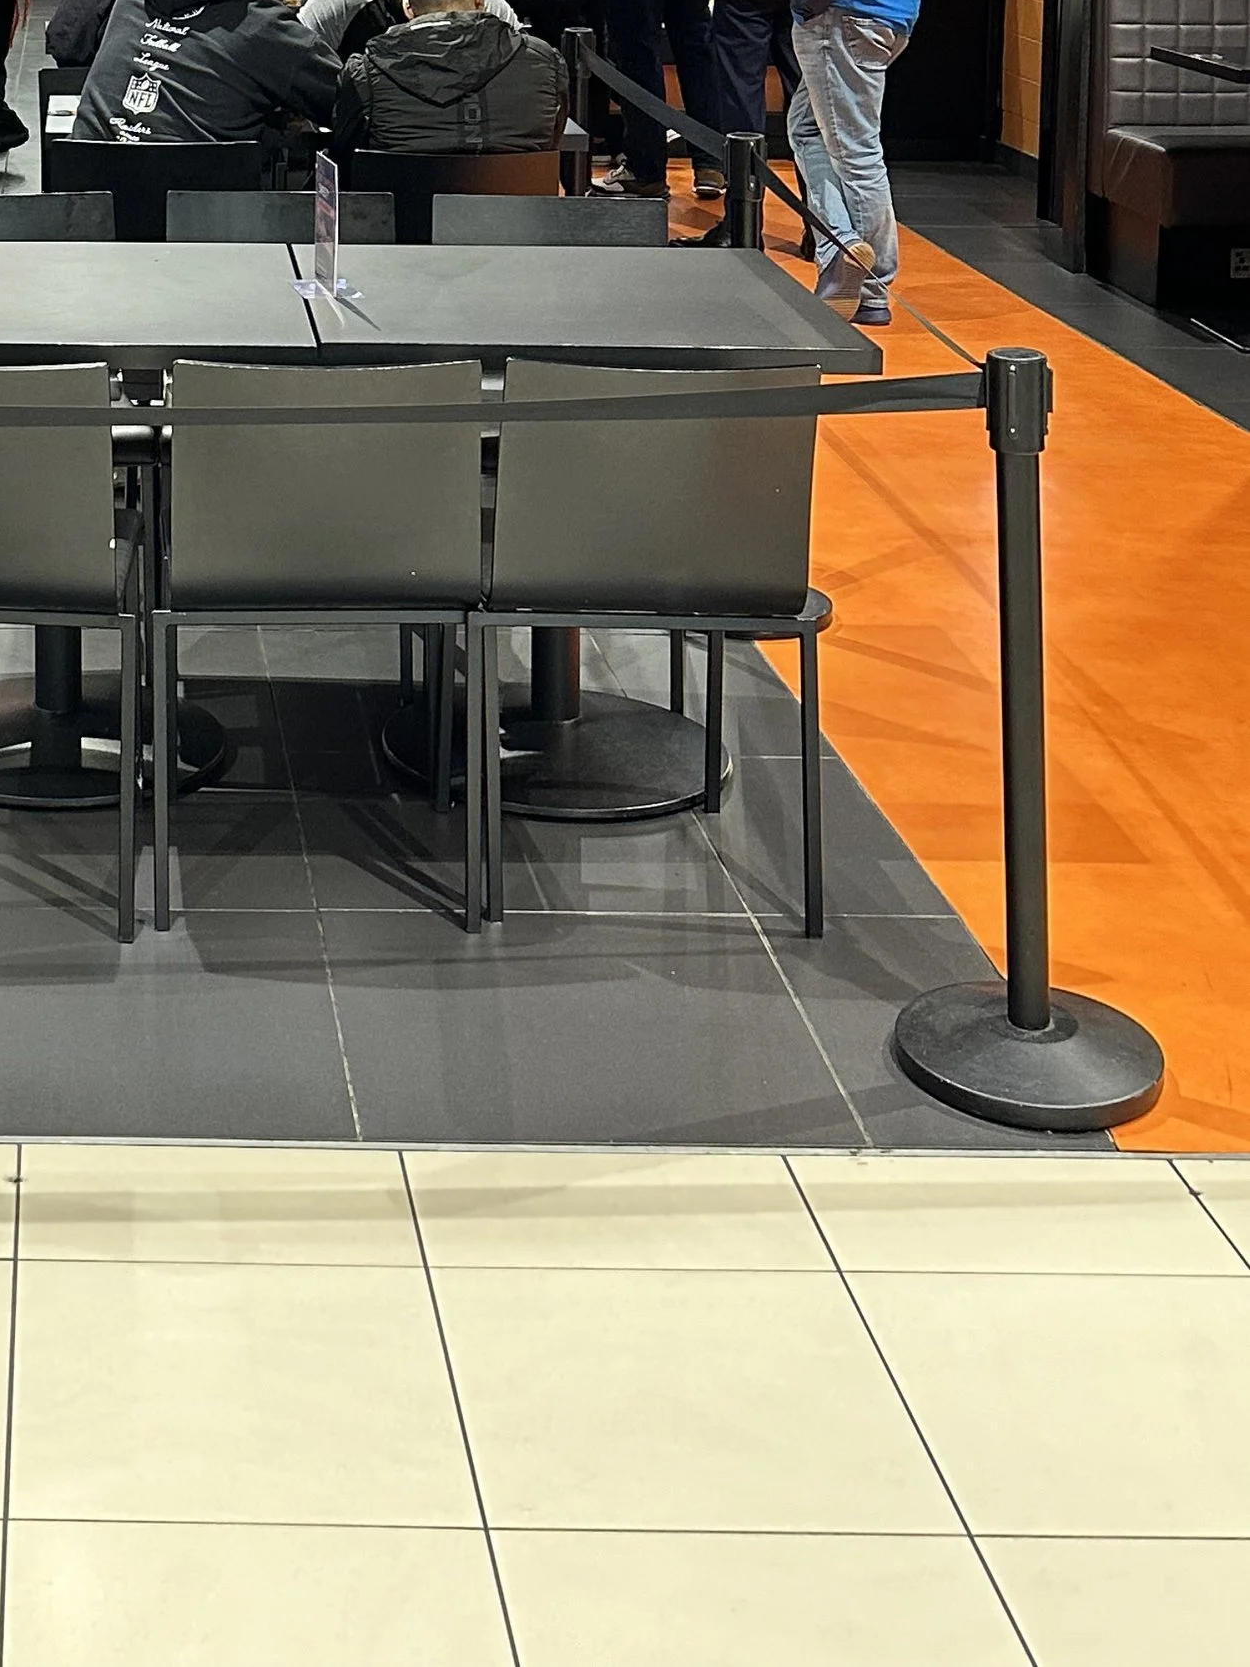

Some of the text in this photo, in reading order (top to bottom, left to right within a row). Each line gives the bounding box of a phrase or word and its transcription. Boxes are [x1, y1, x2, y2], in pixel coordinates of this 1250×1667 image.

[145, 18, 191, 35] National
[133, 52, 170, 72] League
[128, 91, 156, 108] NFL
[110, 117, 152, 135] Raiders
